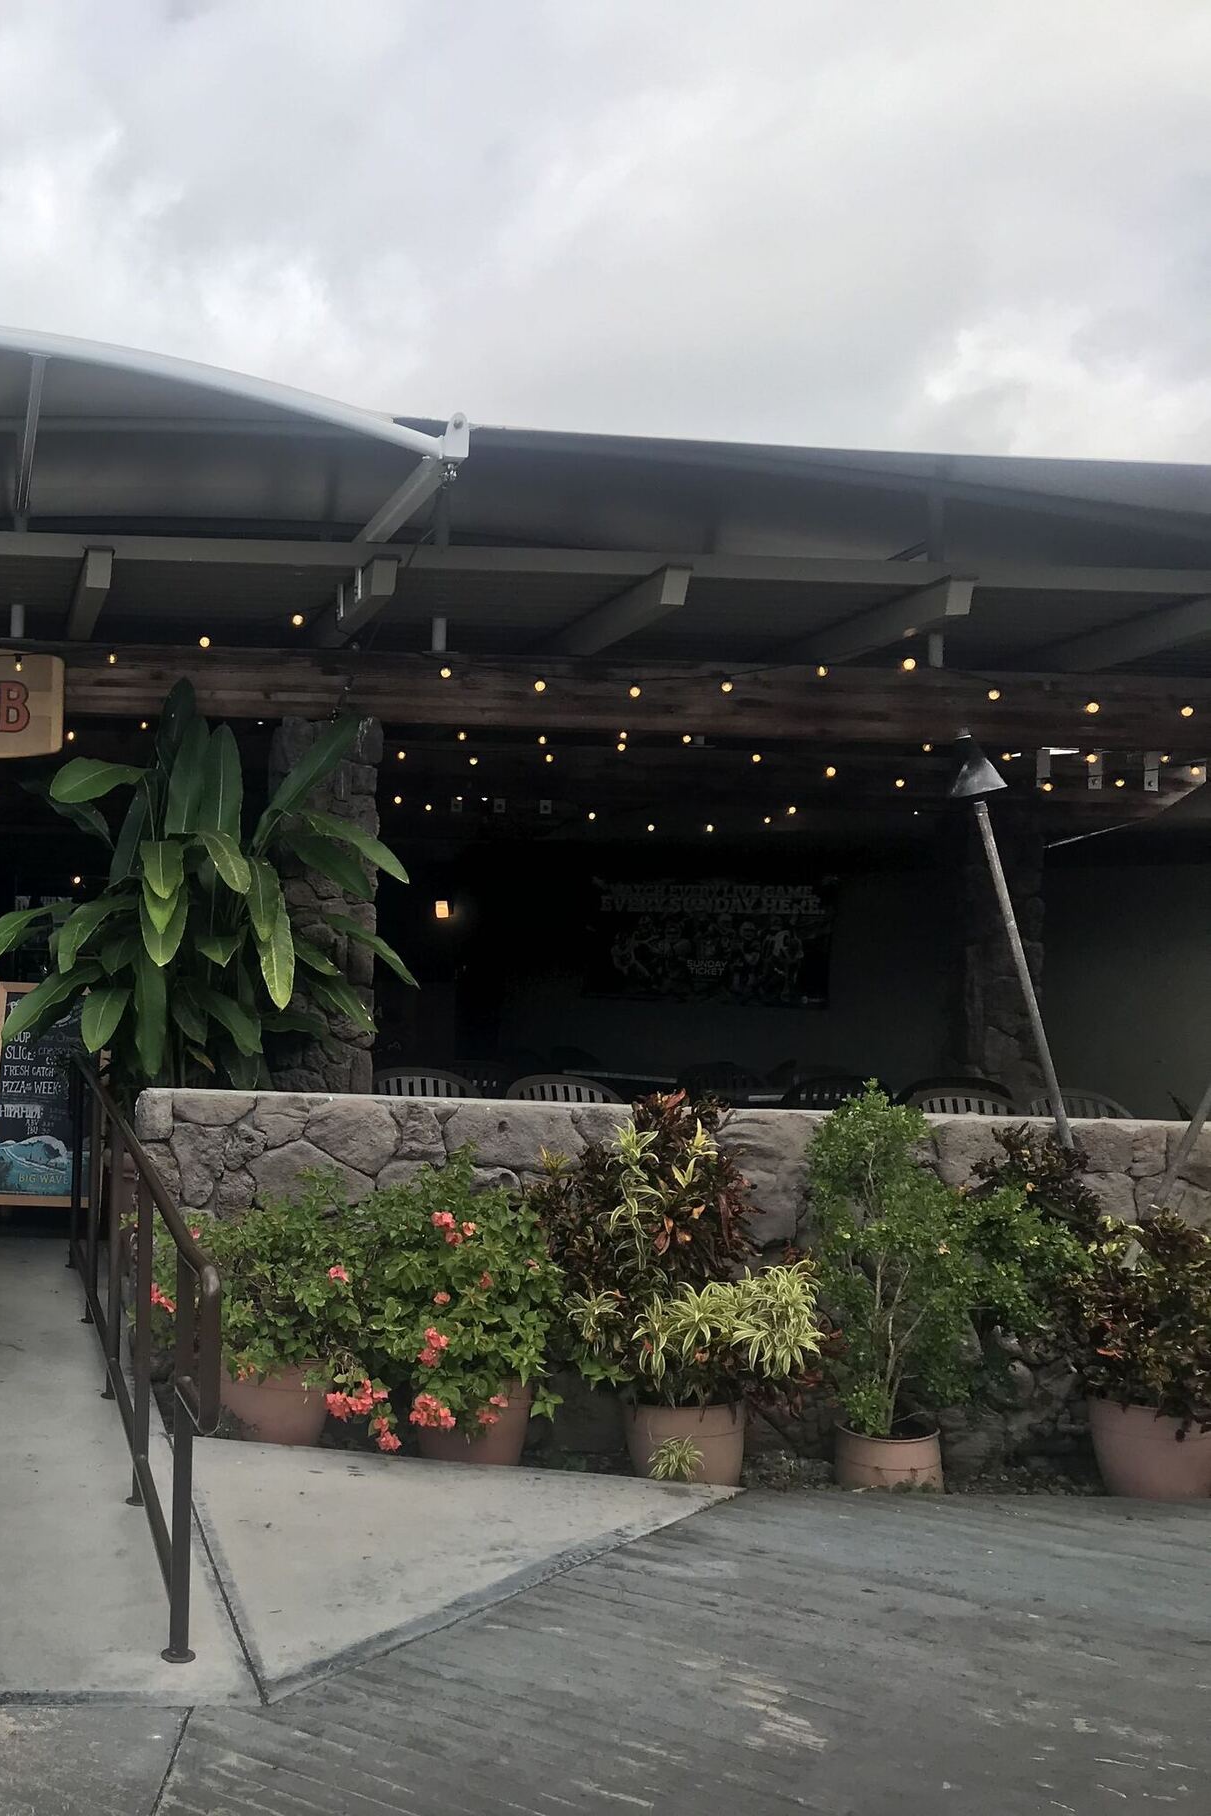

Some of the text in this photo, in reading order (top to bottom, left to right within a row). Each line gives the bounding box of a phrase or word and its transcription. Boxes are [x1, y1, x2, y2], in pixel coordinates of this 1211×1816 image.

[686, 959, 728, 969] SUNDAY
[689, 967, 726, 976] TICKET
[3, 1064, 30, 1077] FRESH
[2, 1081, 26, 1094] PIZZA
[19, 1173, 69, 1185] BIG WAVE
